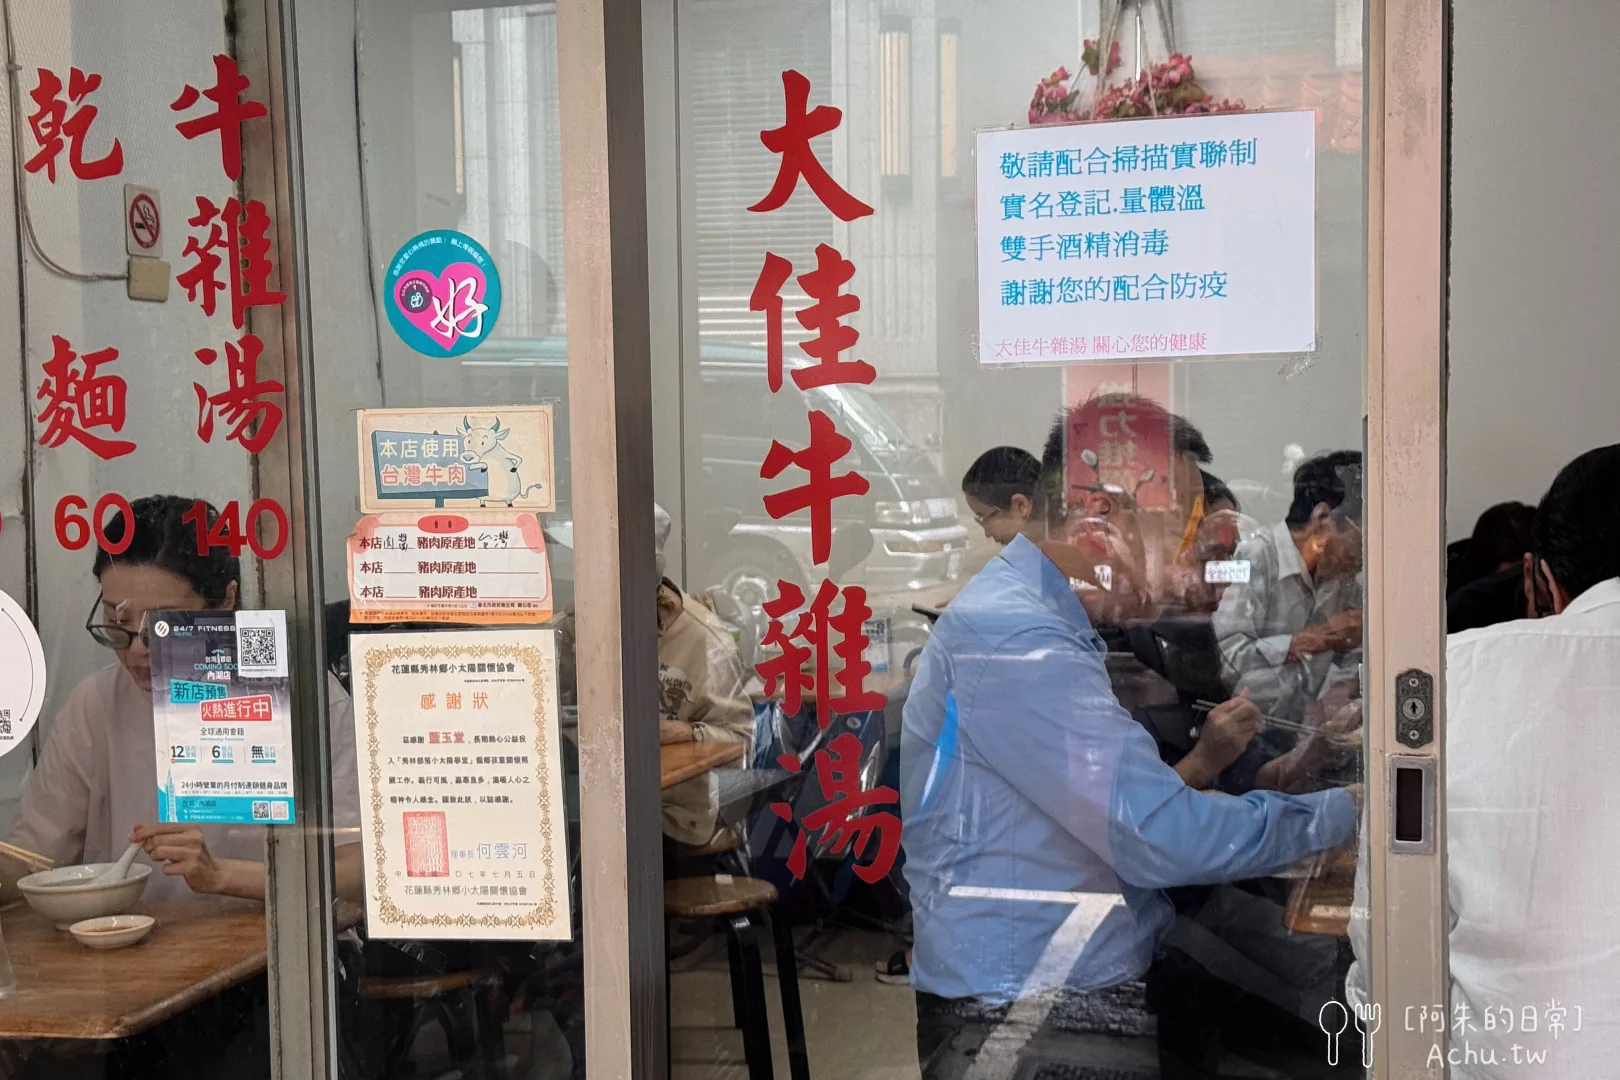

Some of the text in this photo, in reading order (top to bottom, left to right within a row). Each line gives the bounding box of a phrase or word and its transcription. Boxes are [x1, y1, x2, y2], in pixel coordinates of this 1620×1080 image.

[999, 138, 1257, 179] 敬請配合掃描實聯制
[1000, 184, 1205, 220] 實名登記.量體溫
[172, 56, 287, 453] 牛雜湯
[1000, 228, 1169, 262] 雙手酒精消毒
[26, 69, 135, 460] 乾麵
[1000, 271, 1228, 306] 謝謝您的配合防疫
[431, 277, 489, 338] 好
[995, 332, 1207, 357] 大佳牛雜湯 關心您的健康
[379, 439, 459, 459] 本店使用
[382, 465, 465, 485] 台灣牛肉
[749, 71, 901, 882] 大佳牛雜湯
[55, 493, 134, 554] 60
[183, 499, 288, 560] 140
[359, 536, 382, 549] 本店
[417, 536, 476, 549] 豬肉原產地
[478, 530, 509, 549] 台灣
[360, 561, 476, 574] 本店 豬肉原產地
[360, 585, 477, 598] 本店 豬肉原產地
[173, 625, 194, 633] 24/7
[174, 682, 226, 700] 新店預售
[203, 699, 269, 718] 火熱進行中
[421, 692, 489, 710] 感謝狀
[171, 745, 185, 758] 12
[212, 745, 221, 758] 6
[251, 745, 264, 759] 無
[477, 843, 527, 860] 何雲河
